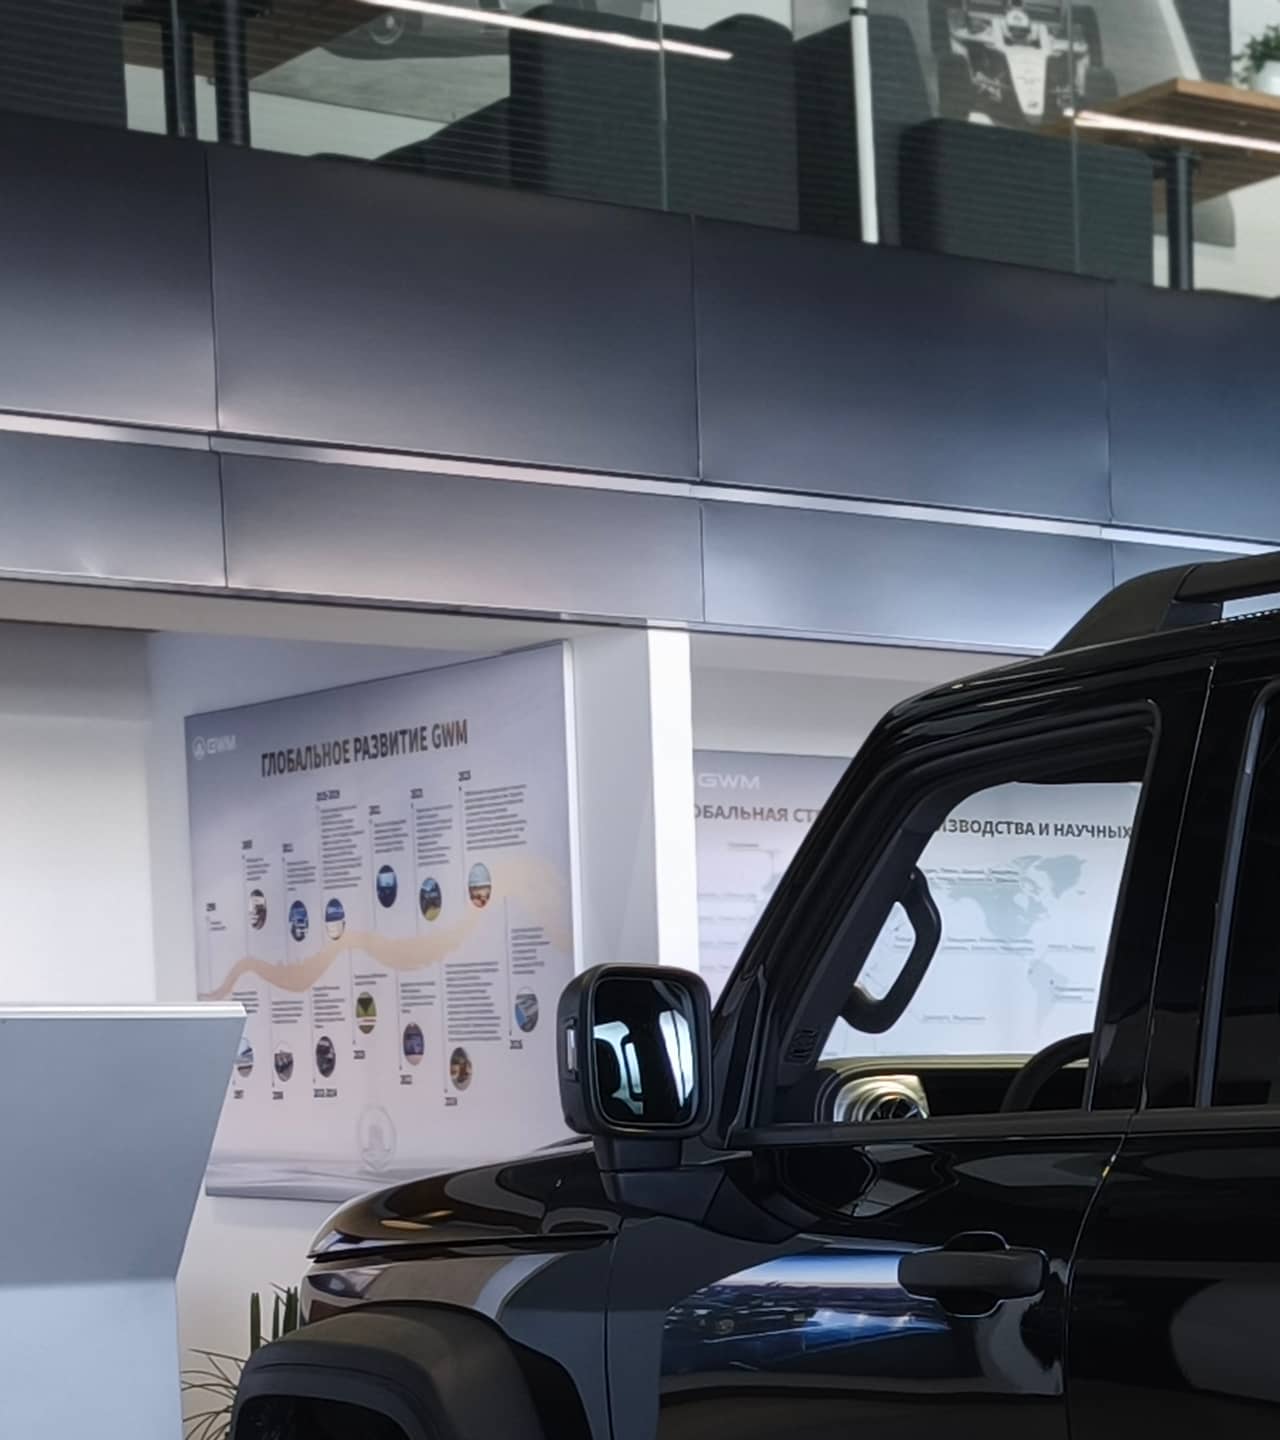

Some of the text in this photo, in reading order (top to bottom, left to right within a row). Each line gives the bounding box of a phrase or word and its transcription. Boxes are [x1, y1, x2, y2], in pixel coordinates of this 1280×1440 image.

[260, 718, 469, 777] ГЛОБАЛЬНОЕ РАЗВИТИЕ GWM
[698, 773, 761, 790] GWM
[1038, 823, 1050, 836] И
